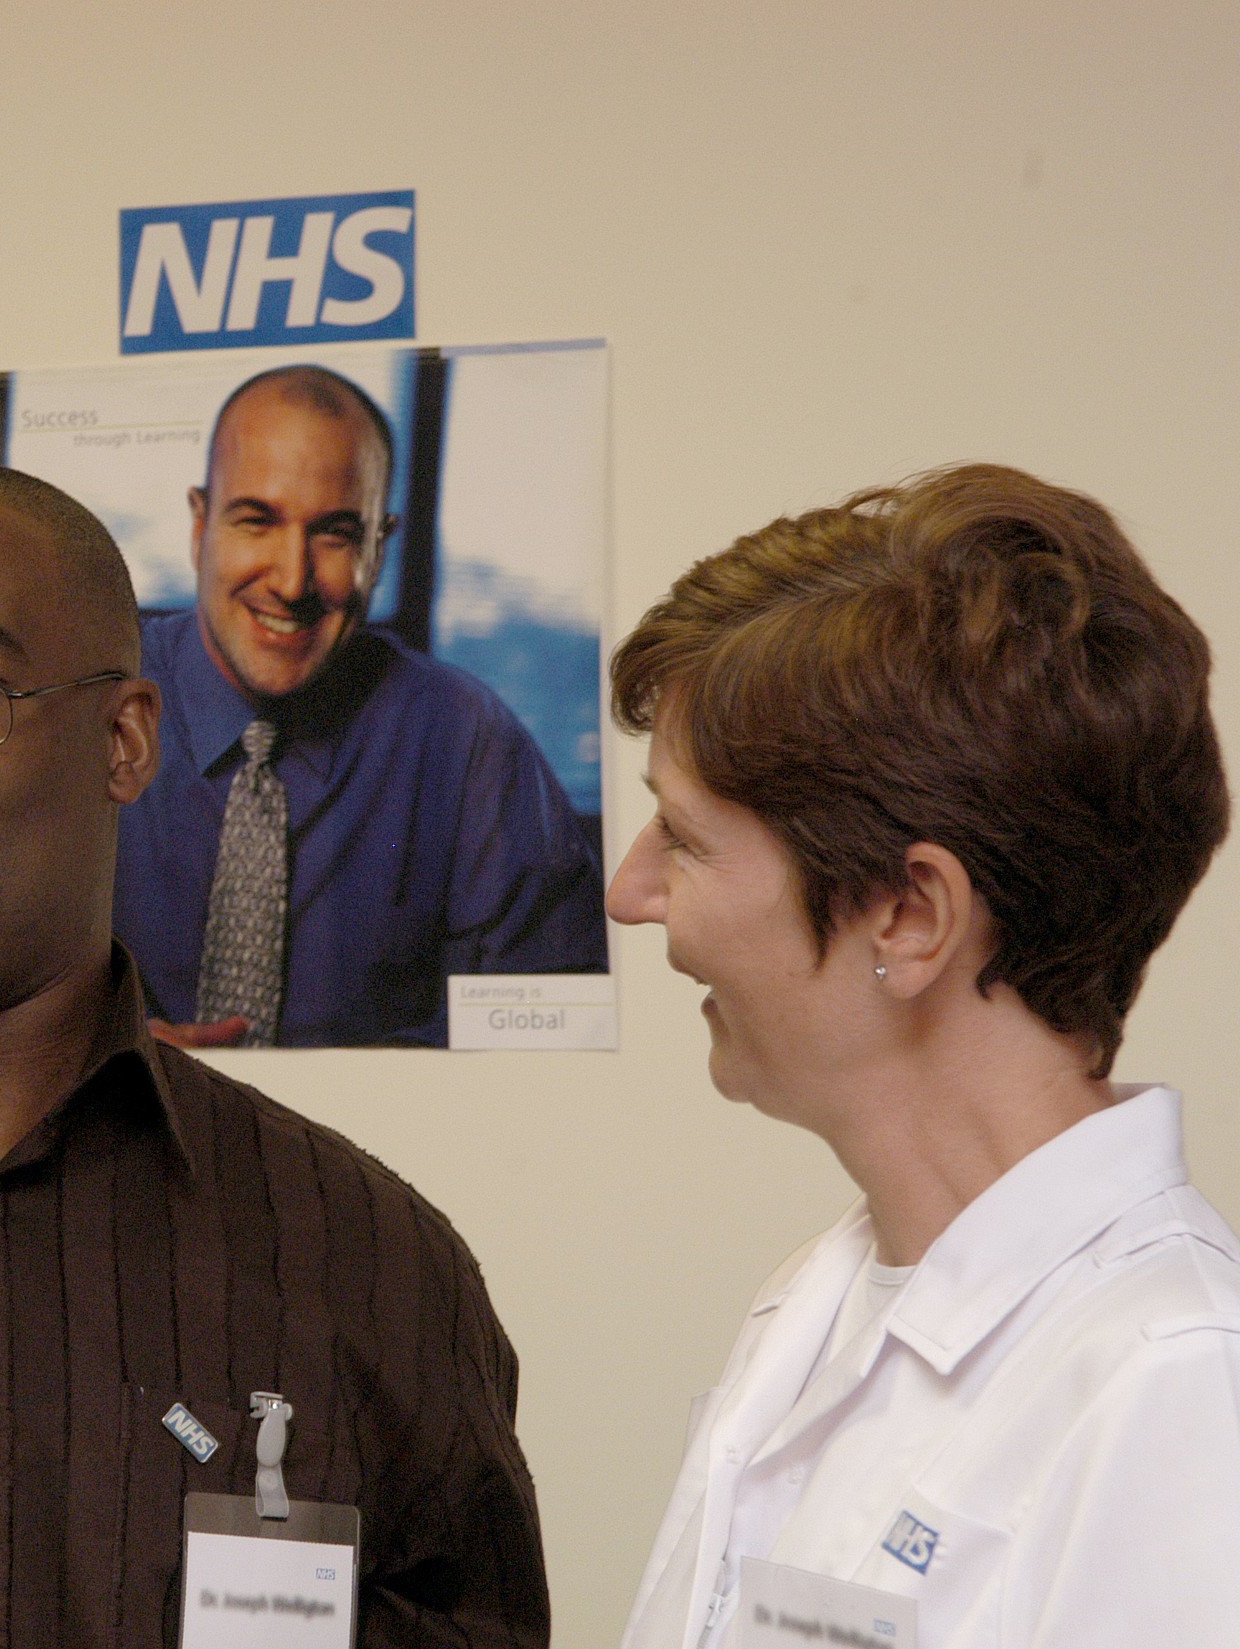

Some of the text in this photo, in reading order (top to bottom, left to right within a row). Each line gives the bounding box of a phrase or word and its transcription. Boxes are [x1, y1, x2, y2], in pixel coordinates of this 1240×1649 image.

[124, 206, 414, 338] NHS
[21, 409, 99, 430] Success
[73, 429, 202, 449] through Learning
[460, 985, 542, 1000] Learning is
[488, 1007, 566, 1031] Global
[167, 1409, 214, 1456] NHS
[885, 1512, 936, 1567] NHS
[316, 1568, 336, 1580] NHS
